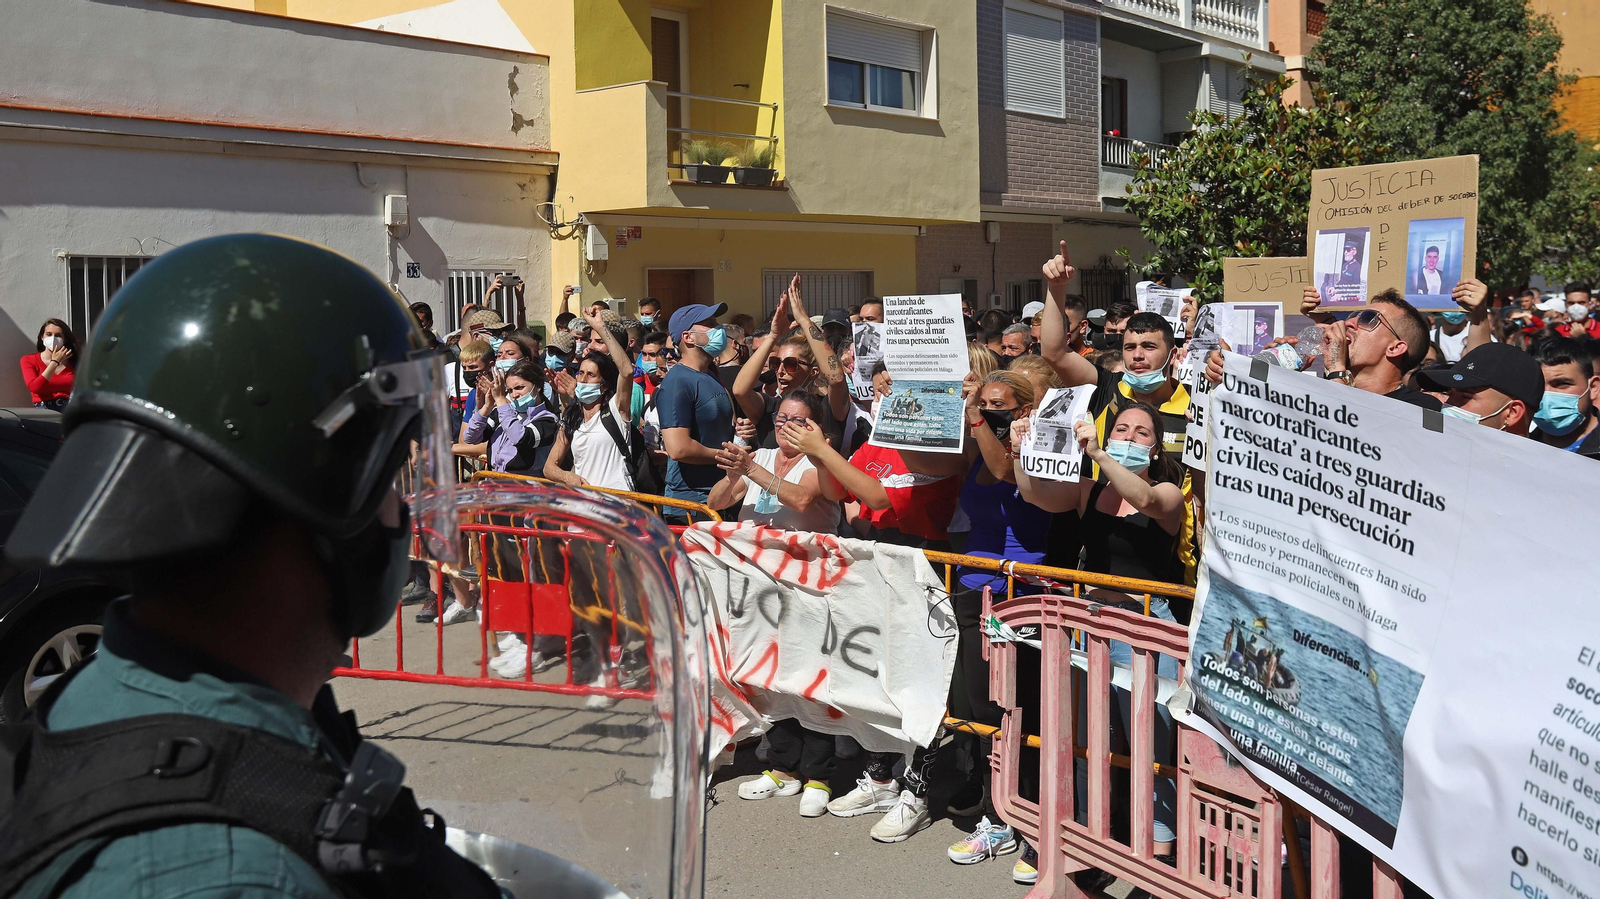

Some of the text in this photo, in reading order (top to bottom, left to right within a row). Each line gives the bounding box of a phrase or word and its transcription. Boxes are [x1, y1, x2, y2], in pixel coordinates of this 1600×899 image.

[1321, 169, 1436, 204] JUSTICIA
[1377, 205, 1392, 214] DEL
[1434, 196, 1444, 205] DE
[407, 264, 420, 278] 33
[718, 260, 732, 272] 35
[886, 297, 925, 306] Una lancha de
[886, 307, 933, 316] narcotraficantes
[886, 327, 904, 335] civiles
[925, 326, 931, 335] al
[926, 316, 955, 326] guardias
[910, 336, 950, 346] persecución
[1224, 372, 1359, 428] Una lancha de
[1221, 398, 1382, 462] narcotraficantes
[1022, 455, 1080, 477] JUSTICIA
[1300, 449, 1311, 463] a
[1315, 450, 1352, 477] tres
[1356, 466, 1446, 512] guardias
[1216, 446, 1412, 526] civiles caídos al mar
[1214, 469, 1415, 557] tras una persecución
[1219, 510, 1427, 604] Los supuestos delincuentes han sido
[1269, 544, 1277, 557] y
[1278, 547, 1345, 587] permanecen
[1347, 579, 1360, 594] en
[1289, 570, 1341, 604] policiales
[1342, 594, 1355, 610] en
[1357, 600, 1398, 632] Málaga
[1020, 626, 1037, 634] NIKE
[1578, 646, 1596, 667] El
[1201, 654, 1240, 682] Todos
[1242, 674, 1264, 694] son
[1266, 689, 1318, 727] personas
[1200, 673, 1219, 693] del
[1223, 683, 1251, 706] lado
[1252, 701, 1274, 720] que
[1315, 736, 1352, 764] todos
[1230, 728, 1253, 749] una
[1230, 710, 1255, 729] una
[1258, 722, 1282, 743] vida
[1284, 738, 1306, 757] por
[1308, 752, 1354, 787] delante
[1538, 728, 1565, 752] que
[1569, 745, 1590, 766] no
[1530, 749, 1569, 785] halle
[1324, 789, 1354, 816] Rangel)
[1518, 802, 1579, 852] hacerlo
